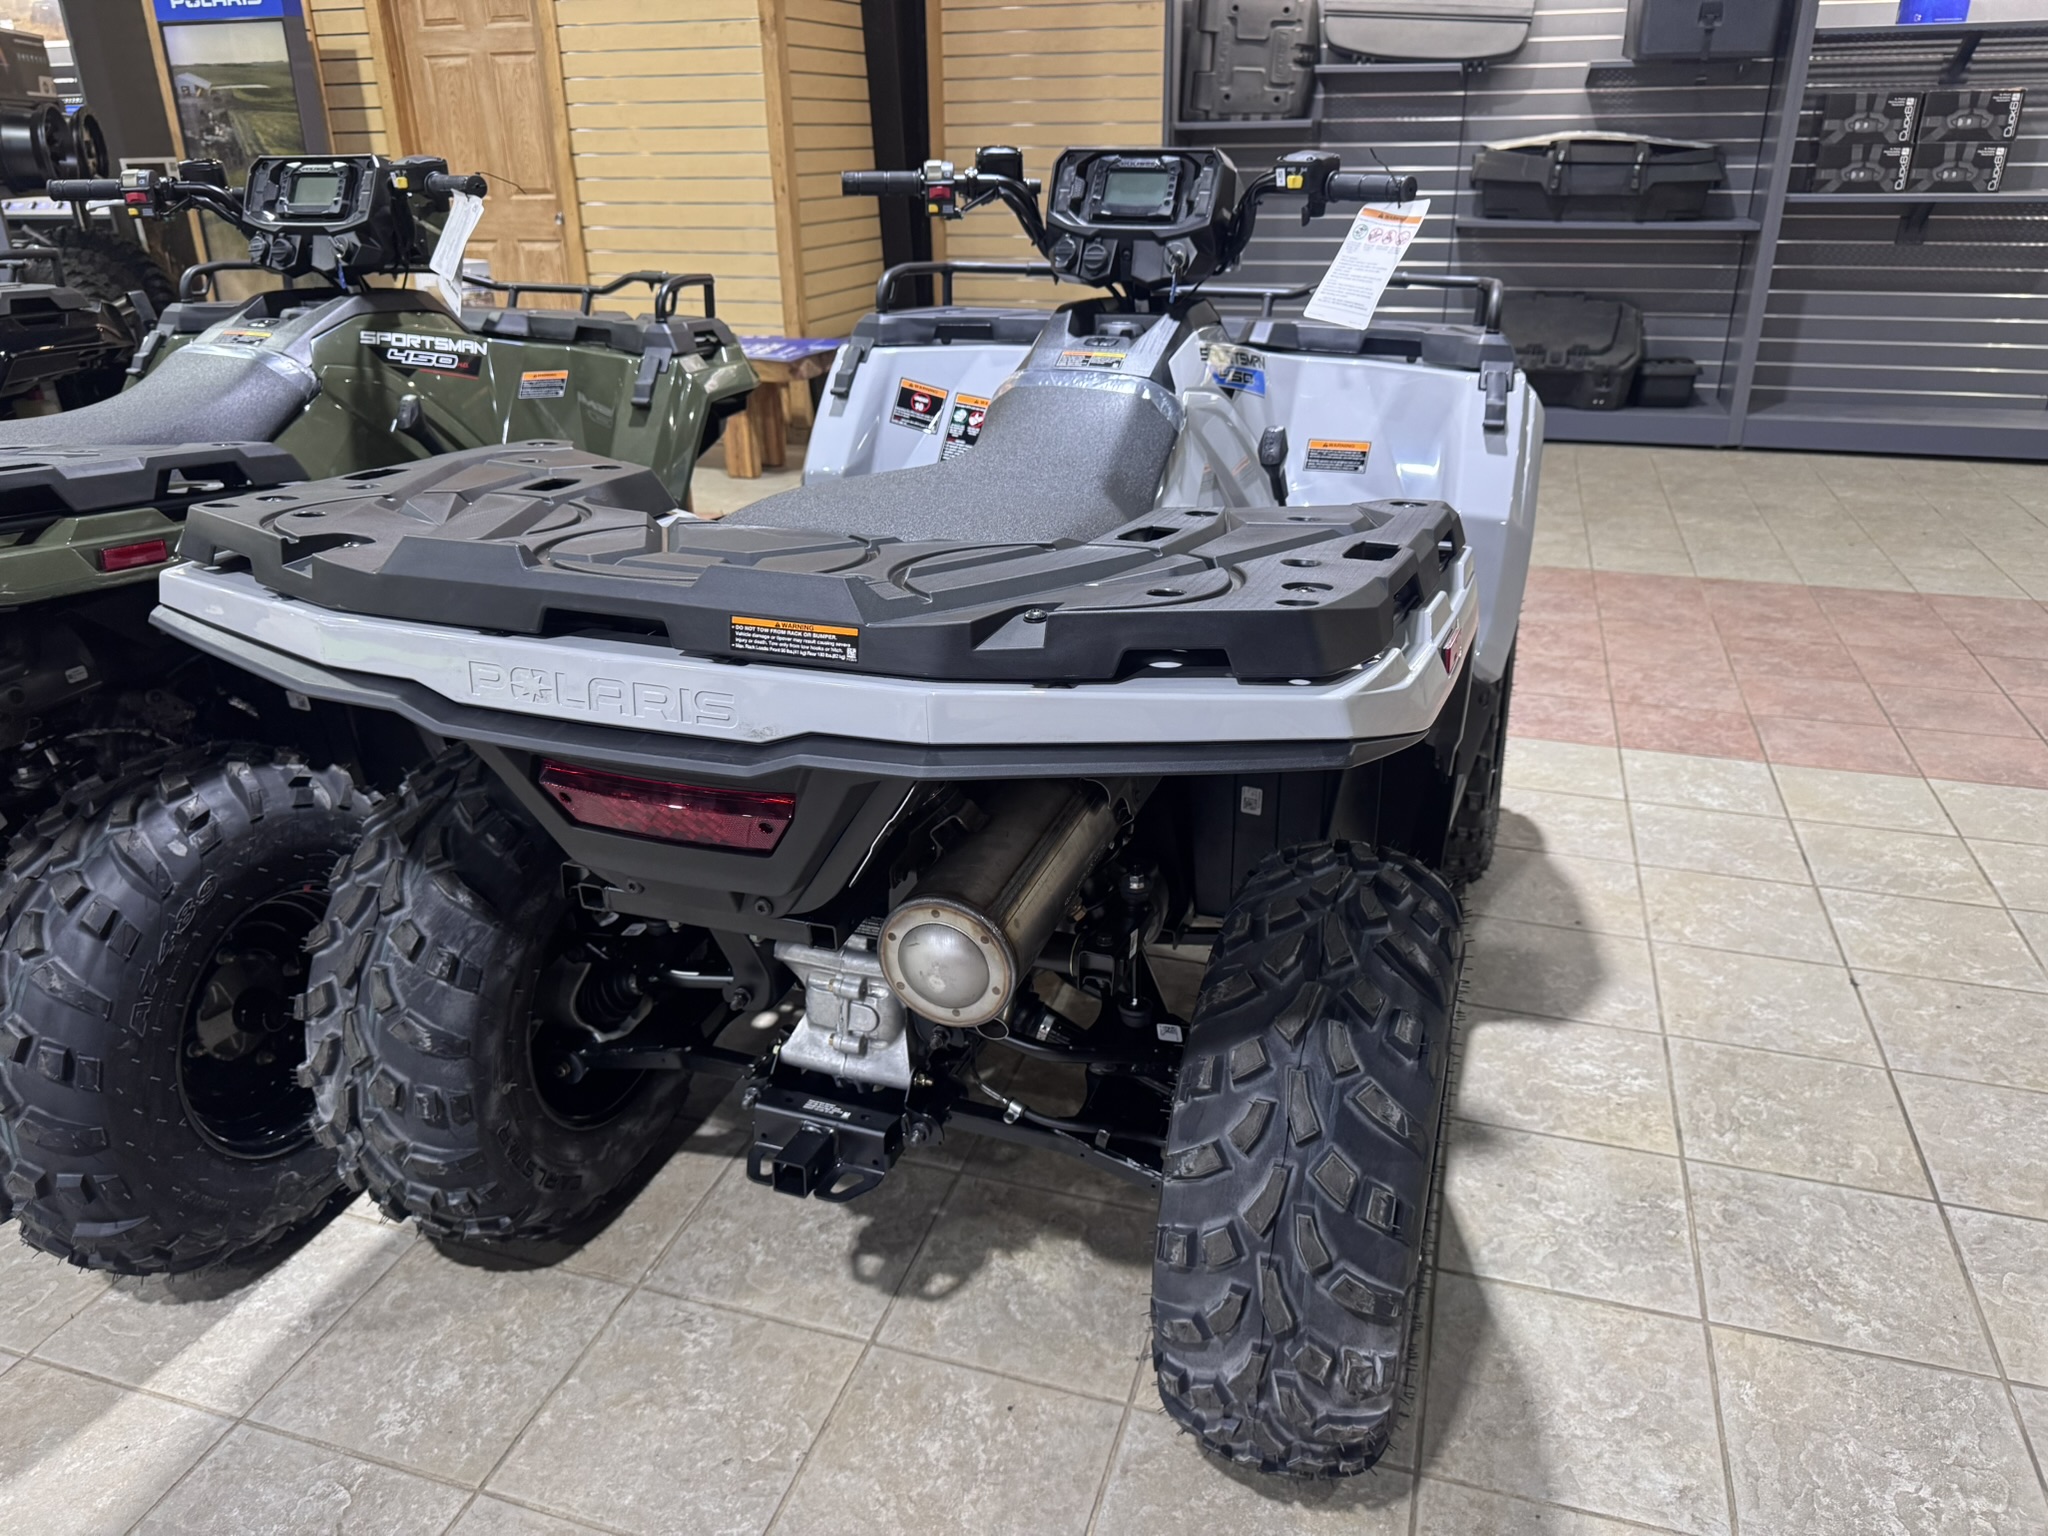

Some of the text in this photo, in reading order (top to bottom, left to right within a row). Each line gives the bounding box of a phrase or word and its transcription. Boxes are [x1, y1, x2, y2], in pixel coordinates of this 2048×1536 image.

[360, 331, 488, 355] SPORTSMAN
[386, 348, 459, 369] 450
[1200, 346, 1266, 370] STSMAN
[468, 660, 739, 730] POLARIS
